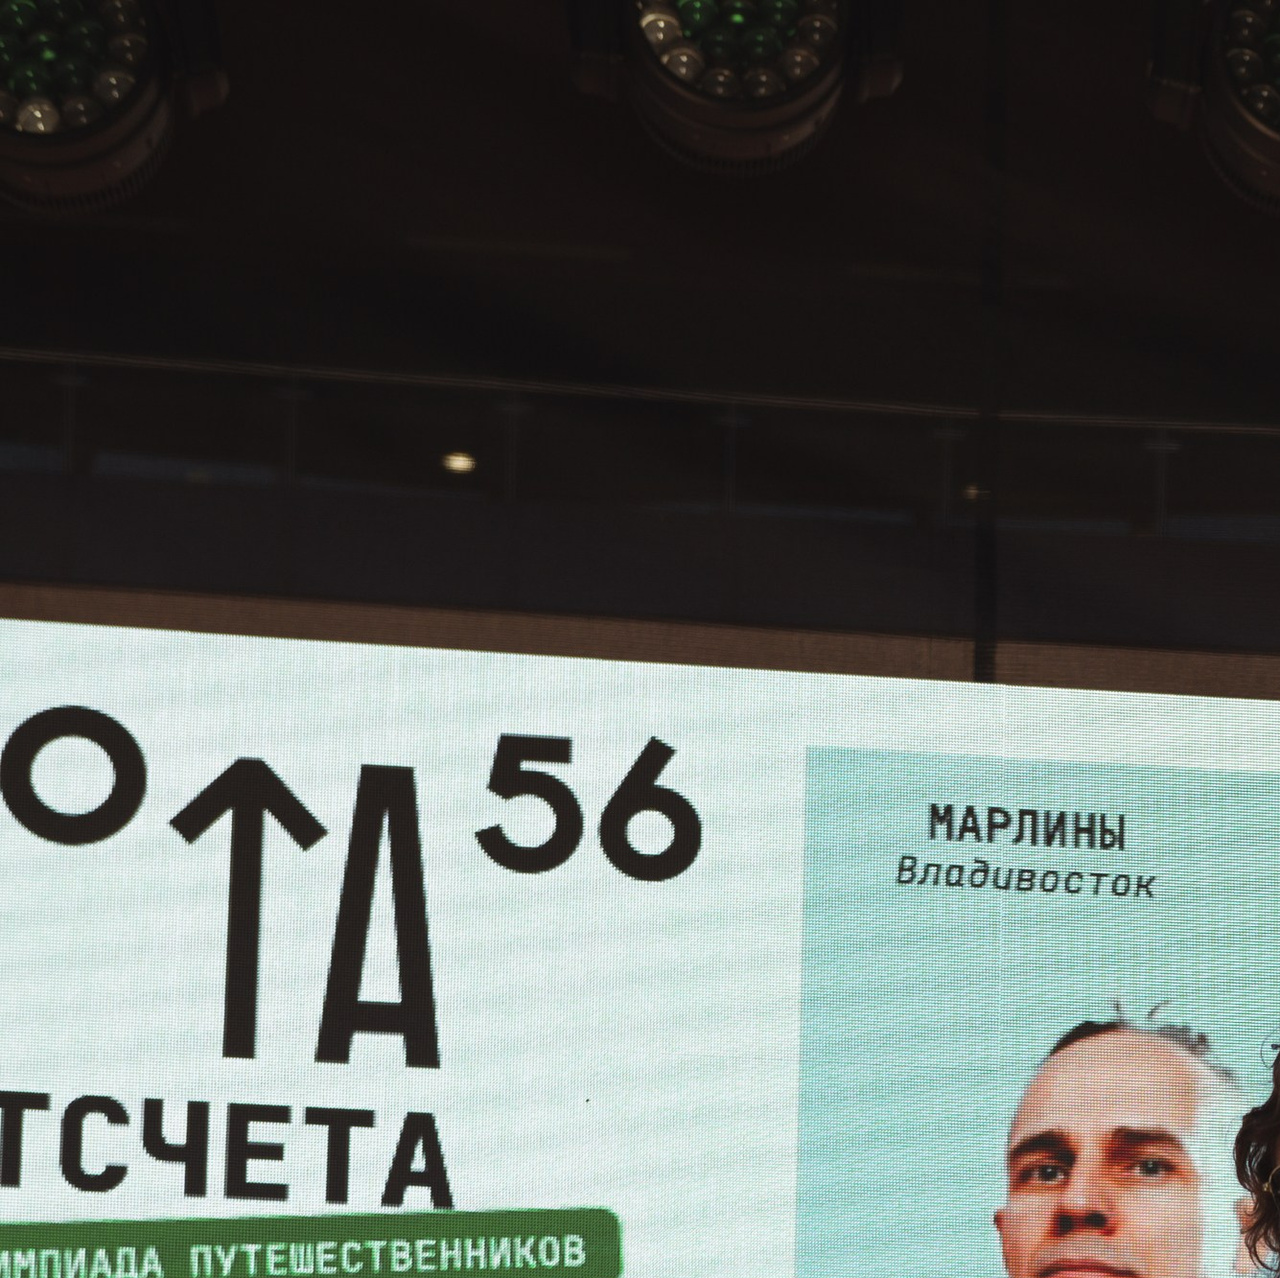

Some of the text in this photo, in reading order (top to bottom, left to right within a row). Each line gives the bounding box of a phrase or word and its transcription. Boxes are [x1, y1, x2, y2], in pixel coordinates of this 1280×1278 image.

[475, 733, 702, 882] 56
[928, 803, 1127, 852] МАРЛИНЫ
[896, 855, 1157, 899] Владивосток
[0, 1090, 455, 1209] ТСЧЕТА
[190, 1234, 587, 1278] ПУТЕШЕСТВЕННИКОВ
